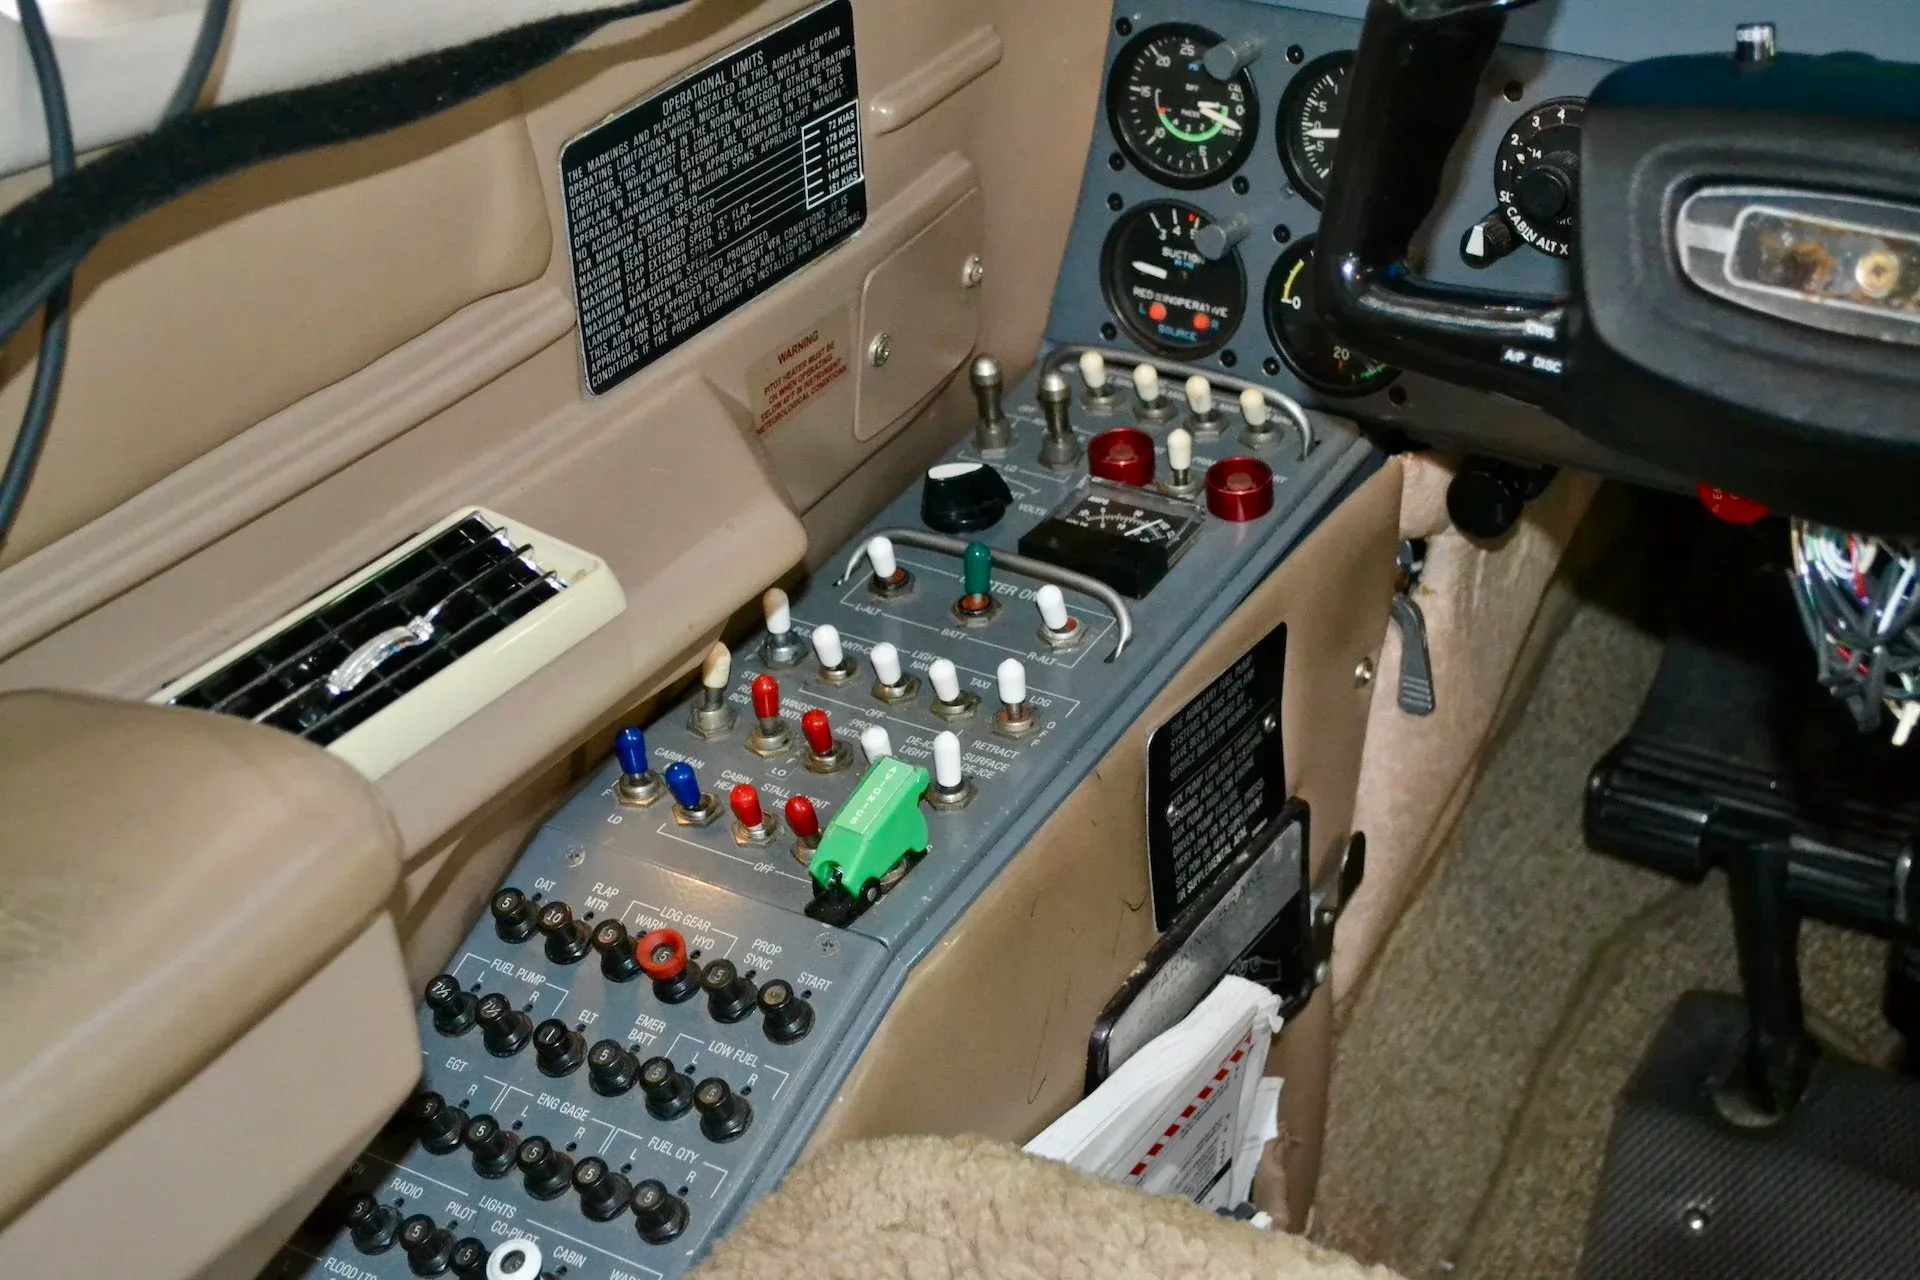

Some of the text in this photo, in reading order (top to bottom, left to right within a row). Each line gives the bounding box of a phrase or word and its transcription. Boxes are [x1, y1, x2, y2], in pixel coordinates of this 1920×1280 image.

[1180, 44, 1195, 57] 25
[1156, 56, 1171, 68] 20
[662, 49, 764, 116] OPERATIONAL LIMITS
[1140, 86, 1151, 98] 15
[567, 25, 840, 184] THE MARKINGS AND PLACARDS INSTALLED IN THIS AIRPLANE CONTAIN
[1318, 102, 1327, 113] 5
[1557, 108, 1566, 121] 4
[568, 49, 820, 198] OPERATING LIMITATIONS WHICH MUST BE COMPLIED WITH WHEN
[1532, 116, 1540, 128] 3
[1155, 127, 1166, 139] 10
[1316, 140, 1325, 152] 5
[1510, 134, 1520, 146] 2
[1199, 146, 1207, 157] 5
[1532, 148, 1542, 159] 14
[1502, 160, 1508, 171] 1
[577, 257, 592, 275] AIR
[595, 232, 634, 264] MINIMUM
[637, 210, 671, 240] CONTROL
[674, 194, 698, 217] SPEED
[837, 108, 855, 126] KIAS
[1500, 190, 1512, 204] SL
[582, 278, 622, 312] MAXIMUM
[626, 264, 645, 285] FLAP
[648, 240, 685, 272] EXTENDED
[732, 201, 750, 221] FLAP
[840, 145, 857, 164] KIAS
[1159, 228, 1168, 241] 3
[1172, 225, 1181, 237] 4
[1506, 206, 1538, 242] CABIN
[1536, 238, 1557, 253] ALT
[585, 303, 625, 337] MAXIMUM
[629, 268, 682, 310] MANEUVERING
[686, 252, 709, 276] SPEED
[841, 169, 858, 188] KIAS
[1292, 296, 1302, 310] 0
[778, 330, 819, 365] WARNING
[1333, 347, 1350, 360] 20
[1532, 356, 1562, 373] DISC
[854, 603, 882, 616] L-ALT
[940, 628, 968, 641] BATT
[1026, 652, 1058, 666] R-ALT
[910, 660, 931, 673] NAV
[969, 677, 993, 690] TAXI
[1029, 695, 1052, 708] LDG
[865, 709, 886, 719] OFF
[849, 719, 872, 731] PRO
[906, 736, 935, 751] DE-IC
[971, 740, 1020, 759] RETRACT
[654, 747, 706, 769] CABIN FAN
[899, 745, 931, 760] LIGHT
[962, 752, 1010, 772] SURFACE
[721, 769, 753, 785] CABIN
[771, 766, 787, 777] LO
[960, 763, 996, 779] DE-ICE
[714, 779, 734, 792] HEA
[761, 782, 792, 799] STALL
[850, 766, 897, 825] AVIONICS
[607, 814, 623, 825] LO
[753, 862, 776, 874] OFF
[534, 877, 557, 893] OAT
[592, 882, 620, 898] FLAP
[502, 897, 512, 909] 5
[584, 896, 609, 913] MTR
[546, 910, 562, 923] 10
[635, 914, 667, 931] WARN
[660, 906, 712, 933] LDG GEAR
[604, 930, 614, 940] 5
[692, 934, 716, 951] HYD
[752, 938, 783, 956] PROP
[659, 951, 670, 962] 5
[744, 953, 774, 971] SYNC
[478, 971, 486, 983] L
[490, 958, 547, 987] FUEL PUMP
[714, 969, 725, 981] 5
[798, 972, 833, 992] START
[529, 990, 540, 1003] R
[578, 1010, 600, 1025] ELT
[635, 1014, 667, 1034] EMER
[627, 1028, 657, 1047] BATT
[600, 1050, 610, 1061] 5
[692, 1052, 700, 1065] L
[708, 1040, 760, 1068] LOW FUEL
[446, 1056, 469, 1073] EGT
[747, 1073, 759, 1086] R
[466, 1084, 479, 1097] R
[423, 1102, 433, 1114] 5
[520, 1105, 529, 1118] L
[536, 1092, 591, 1122] ENG GAGE
[476, 1125, 487, 1137] 5
[574, 1126, 586, 1140] R
[528, 1146, 539, 1159] 5
[630, 1148, 638, 1161] L
[648, 1136, 700, 1165] FUEL QTY
[586, 1168, 595, 1180] 5
[685, 1170, 697, 1184] R
[390, 1177, 424, 1199] RADIO
[644, 1191, 654, 1203] 5
[354, 1202, 365, 1214] 5
[445, 1200, 477, 1222] PILOT
[478, 1195, 517, 1219] LIGHTS
[412, 1226, 422, 1237] 5
[464, 1250, 473, 1261] 5
[553, 1246, 587, 1269] CABIN
[324, 1257, 359, 1279] FLOOD
